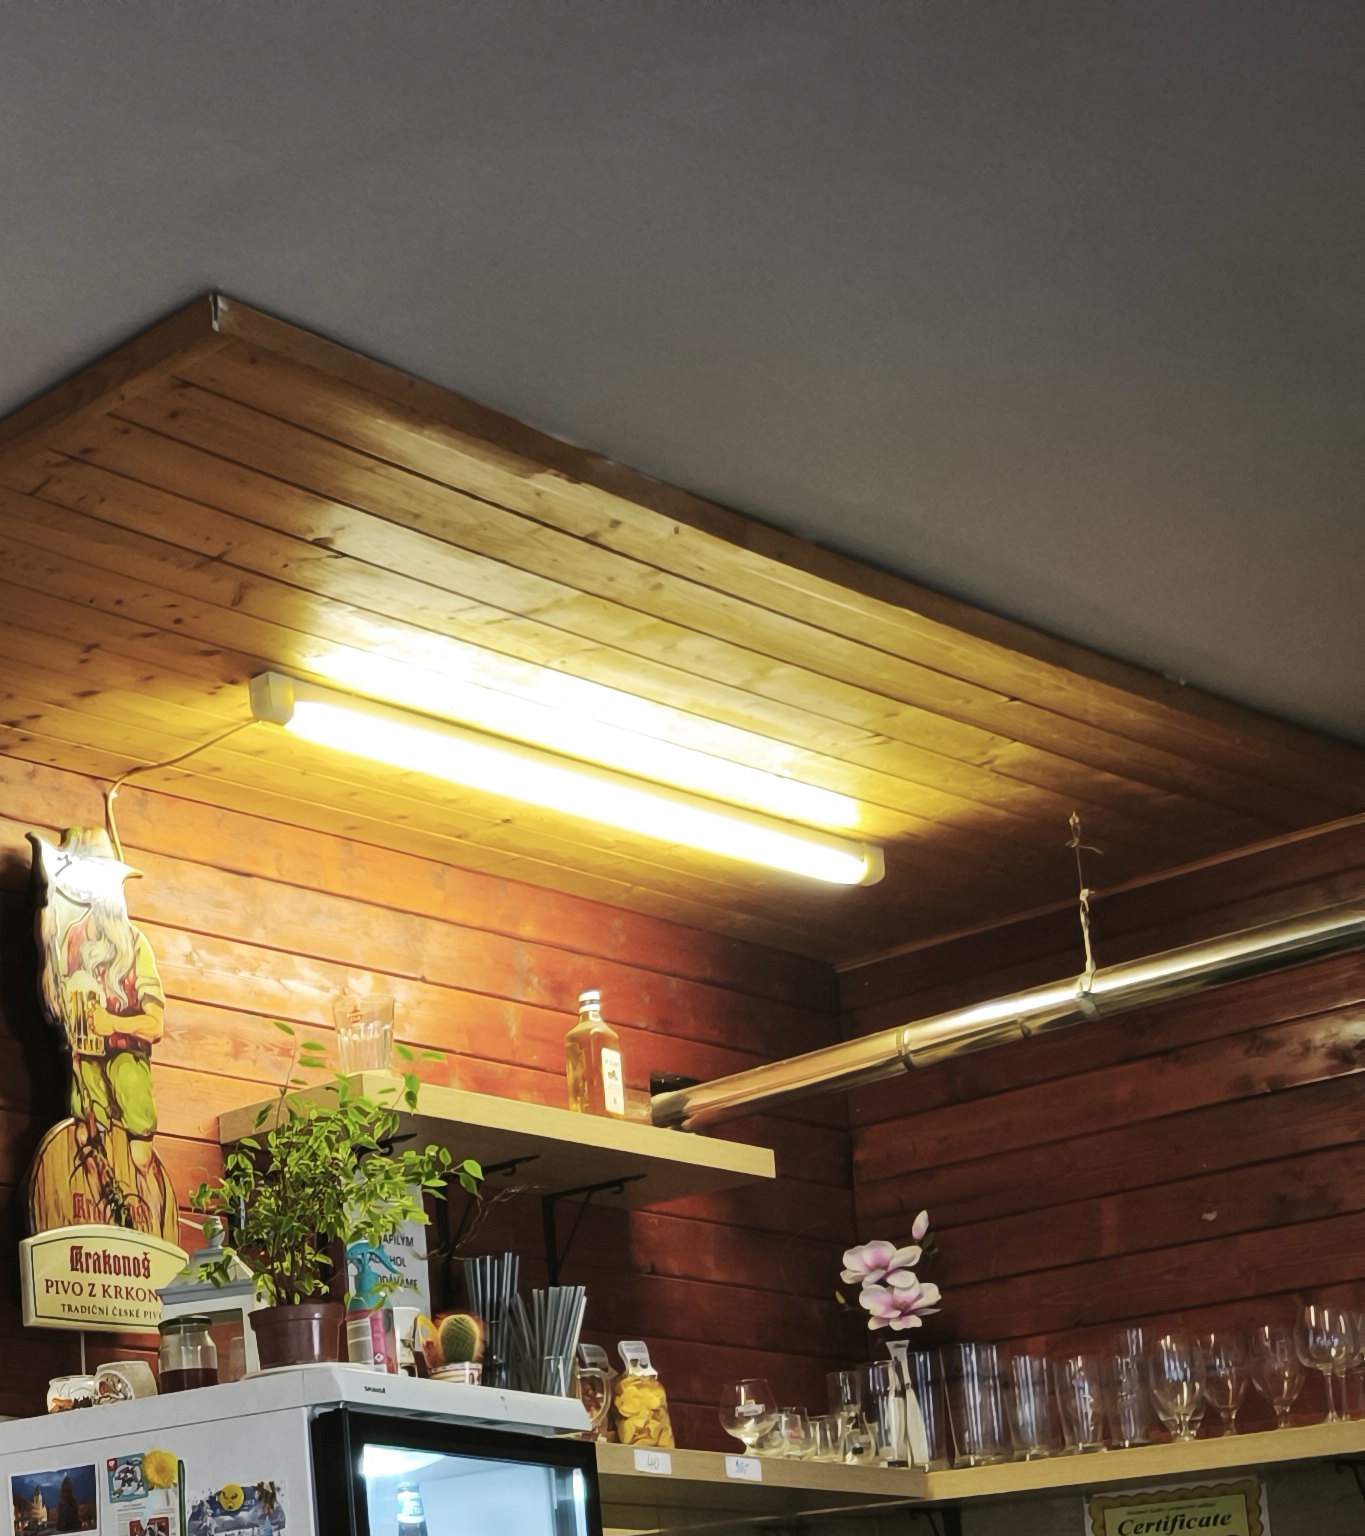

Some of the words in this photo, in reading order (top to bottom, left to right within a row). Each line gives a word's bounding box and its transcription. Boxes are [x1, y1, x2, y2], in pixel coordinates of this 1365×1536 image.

[70, 1245, 151, 1280] Krakonoš
[44, 1278, 84, 1297] PIVO
[87, 1282, 97, 1298] Z
[101, 1283, 159, 1303] KRKON
[61, 1303, 109, 1317] TRADIČNÍ
[112, 1305, 140, 1319] ČESKÉ
[1117, 1513, 1232, 1536] Certificate
